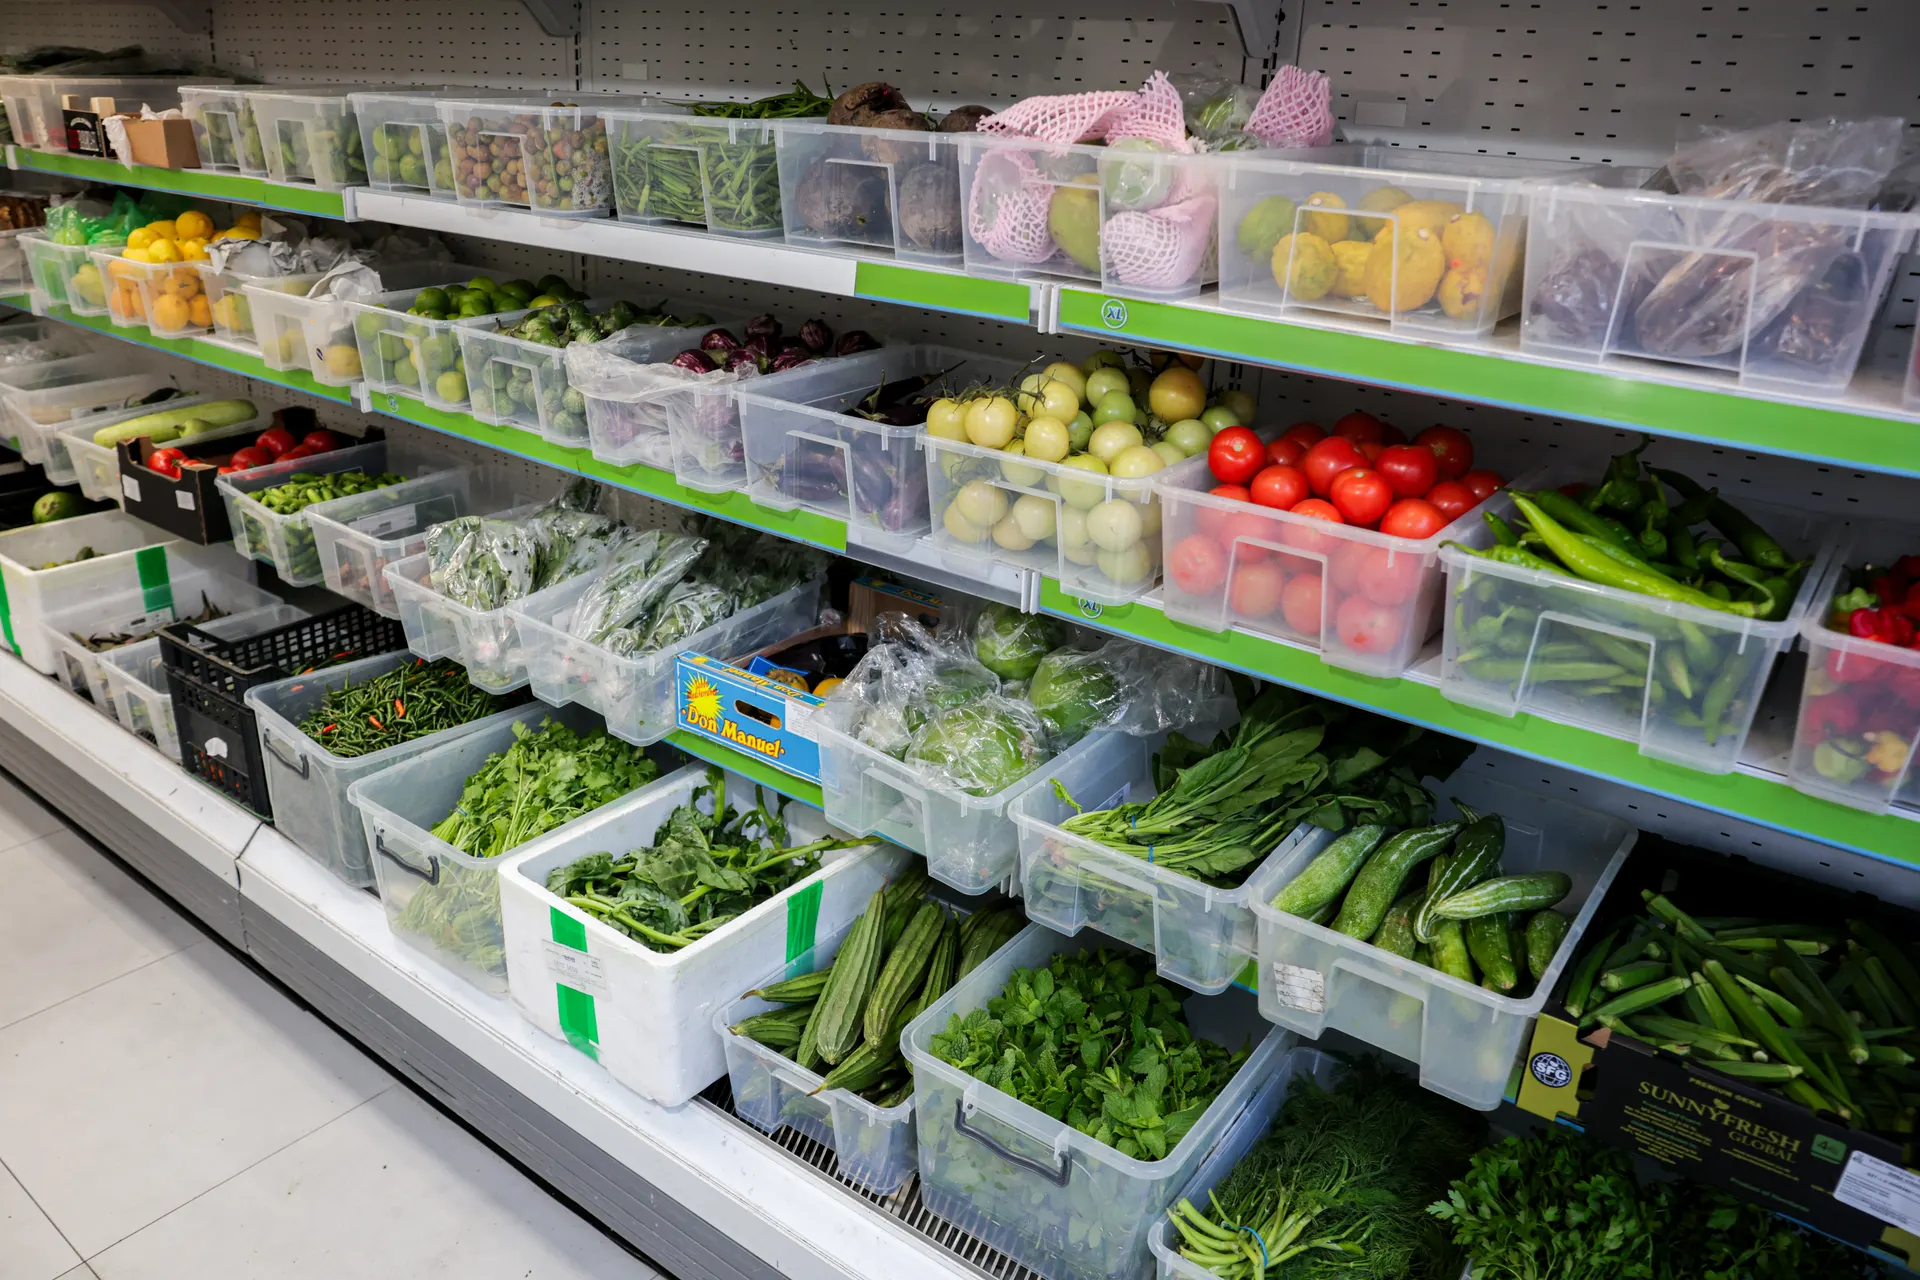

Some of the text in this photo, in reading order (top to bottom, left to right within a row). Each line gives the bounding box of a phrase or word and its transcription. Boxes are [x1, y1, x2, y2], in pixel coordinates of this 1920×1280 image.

[1106, 306, 1122, 321] XL
[1083, 600, 1098, 611] XL
[686, 704, 781, 758] Don Manuel
[1536, 1062, 1567, 1081] SFG
[1688, 1077, 1763, 1109] PREMIUM OKRA
[1638, 1080, 1802, 1153] SUNNYFRESH
[1728, 1131, 1796, 1164] GLOBAL
